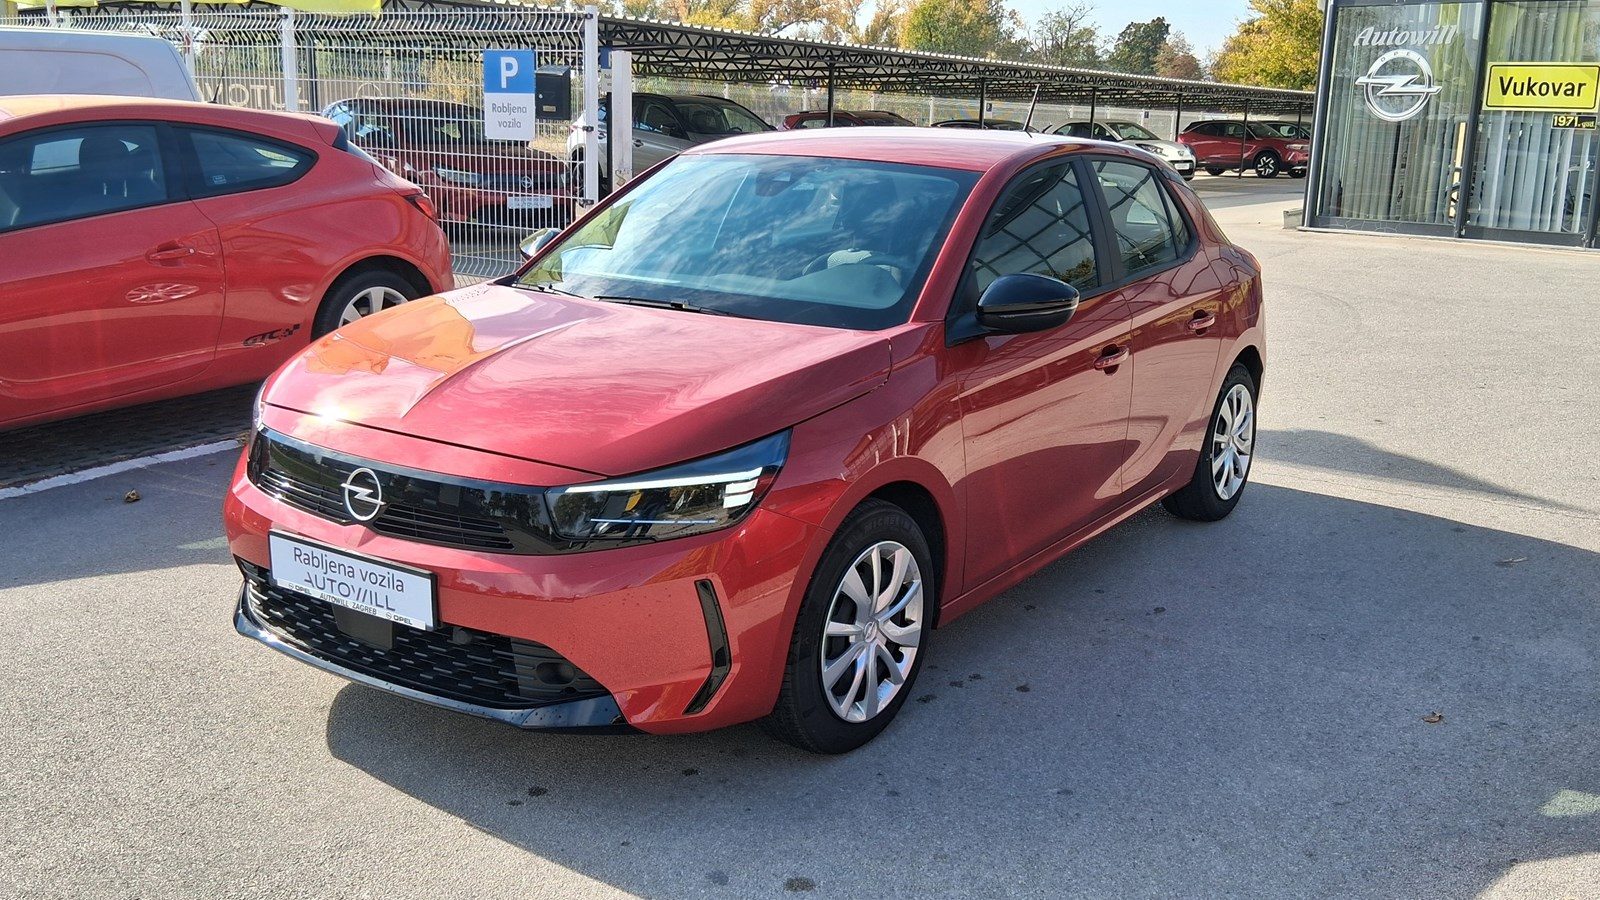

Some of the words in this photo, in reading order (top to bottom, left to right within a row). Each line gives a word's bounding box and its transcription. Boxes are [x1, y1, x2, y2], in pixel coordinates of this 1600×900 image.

[1353, 24, 1458, 47] Autowill
[1380, 51, 1422, 63] OPEL
[500, 56, 519, 89] P
[1499, 76, 1587, 97] Vukovar
[491, 102, 528, 114] Rabljena
[497, 119, 522, 129] vozila
[1553, 115, 1581, 128] 1971.
[293, 547, 355, 579] Rabljena
[359, 568, 405, 593] vozila
[303, 571, 396, 612] AUTOWILL
[294, 585, 312, 595] OPEL
[319, 592, 350, 608] AUTOWILL
[352, 602, 377, 616] ZAGREB
[393, 614, 413, 626] OPEL
